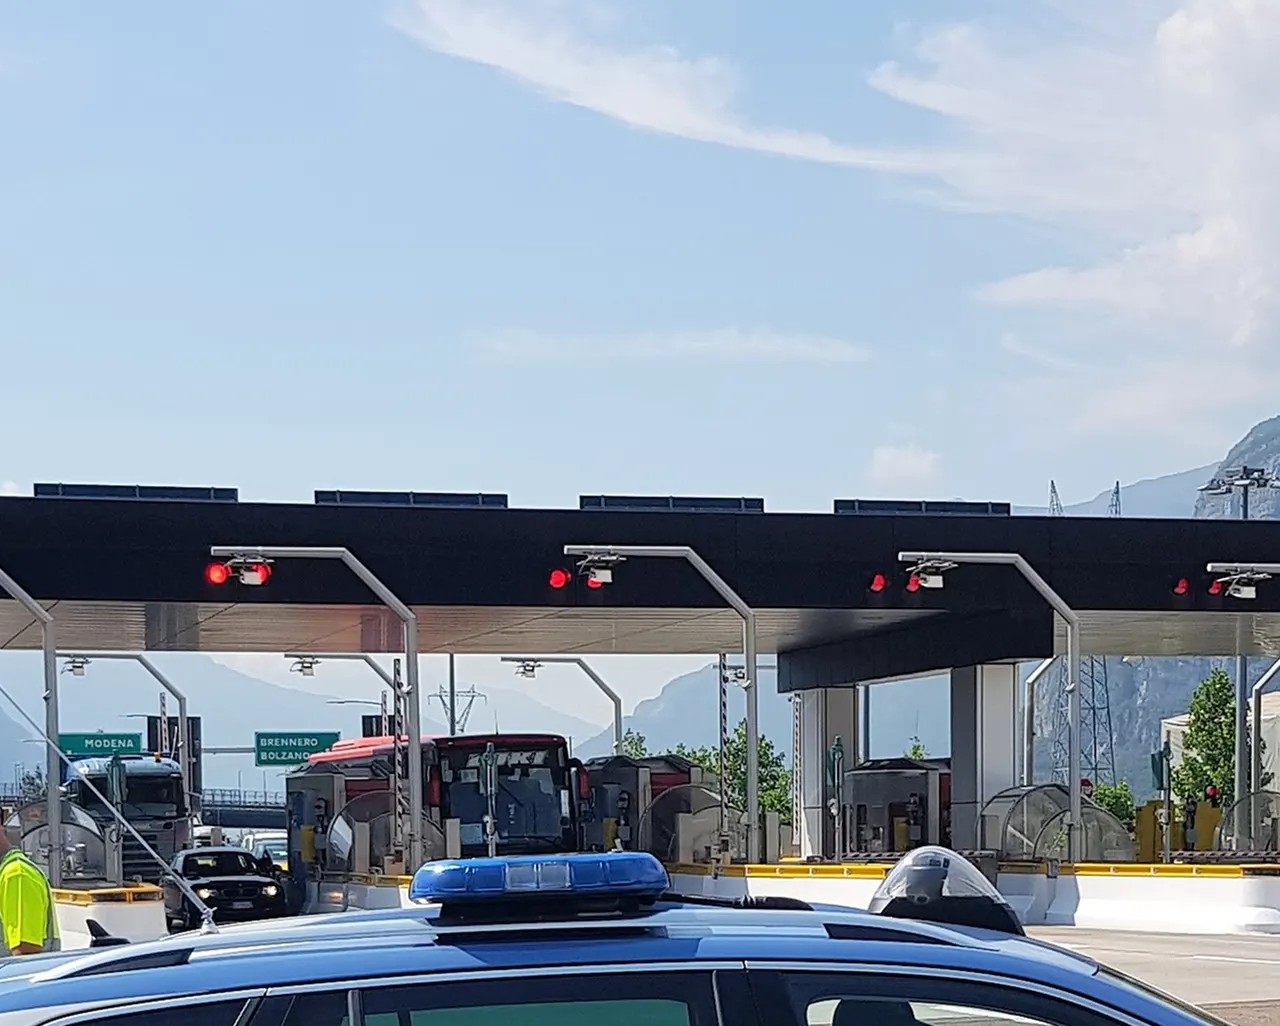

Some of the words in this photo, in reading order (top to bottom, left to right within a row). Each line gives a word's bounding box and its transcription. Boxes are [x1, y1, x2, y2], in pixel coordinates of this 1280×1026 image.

[84, 738, 135, 748] MODENA
[259, 737, 319, 747] BRENNERO
[260, 751, 310, 760] BOLZANO
